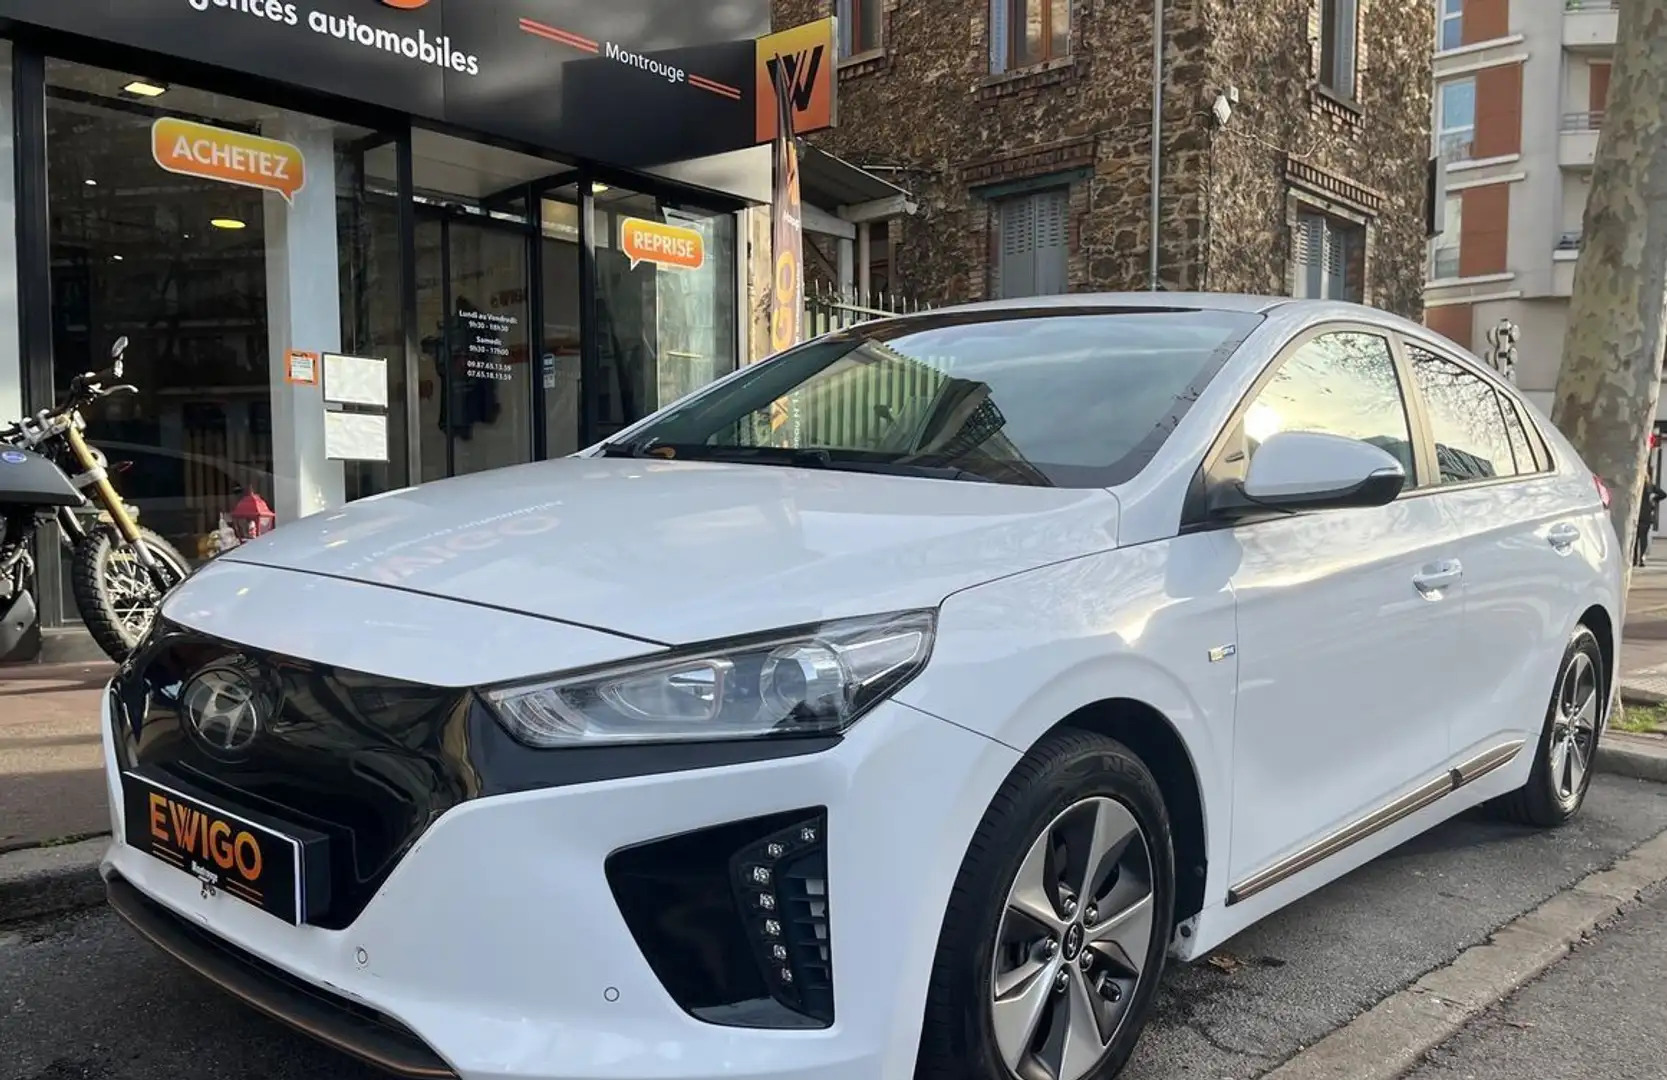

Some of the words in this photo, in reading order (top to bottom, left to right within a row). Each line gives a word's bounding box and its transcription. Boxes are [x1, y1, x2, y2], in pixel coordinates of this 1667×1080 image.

[308, 11, 478, 75] automobiles
[605, 41, 685, 83] Montrouge
[172, 135, 289, 180] ACHETEZ
[633, 230, 695, 258] REPRISE
[149, 791, 263, 881] EWIGO
